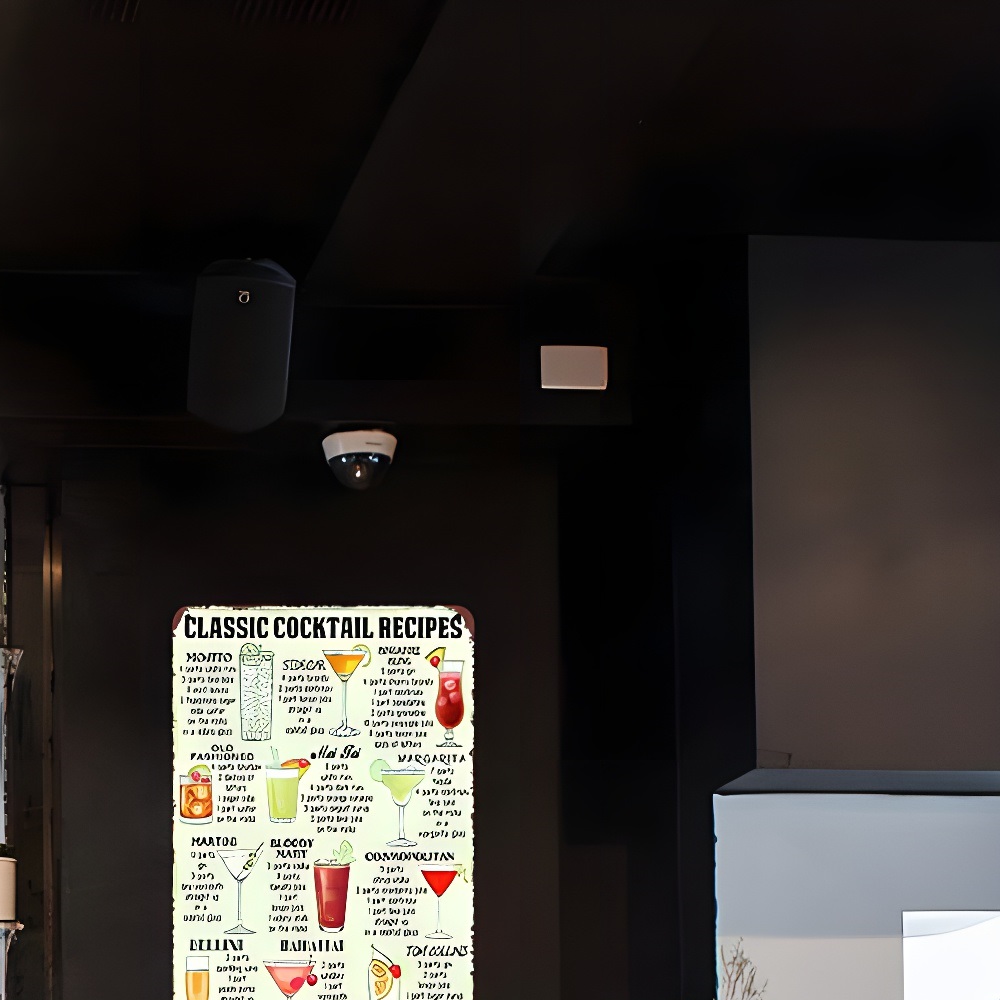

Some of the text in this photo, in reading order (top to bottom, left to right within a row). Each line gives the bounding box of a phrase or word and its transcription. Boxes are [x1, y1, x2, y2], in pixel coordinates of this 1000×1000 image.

[184, 614, 463, 639] CLASSIC COCKTAIL RECIPES
[211, 744, 234, 753] OLD
